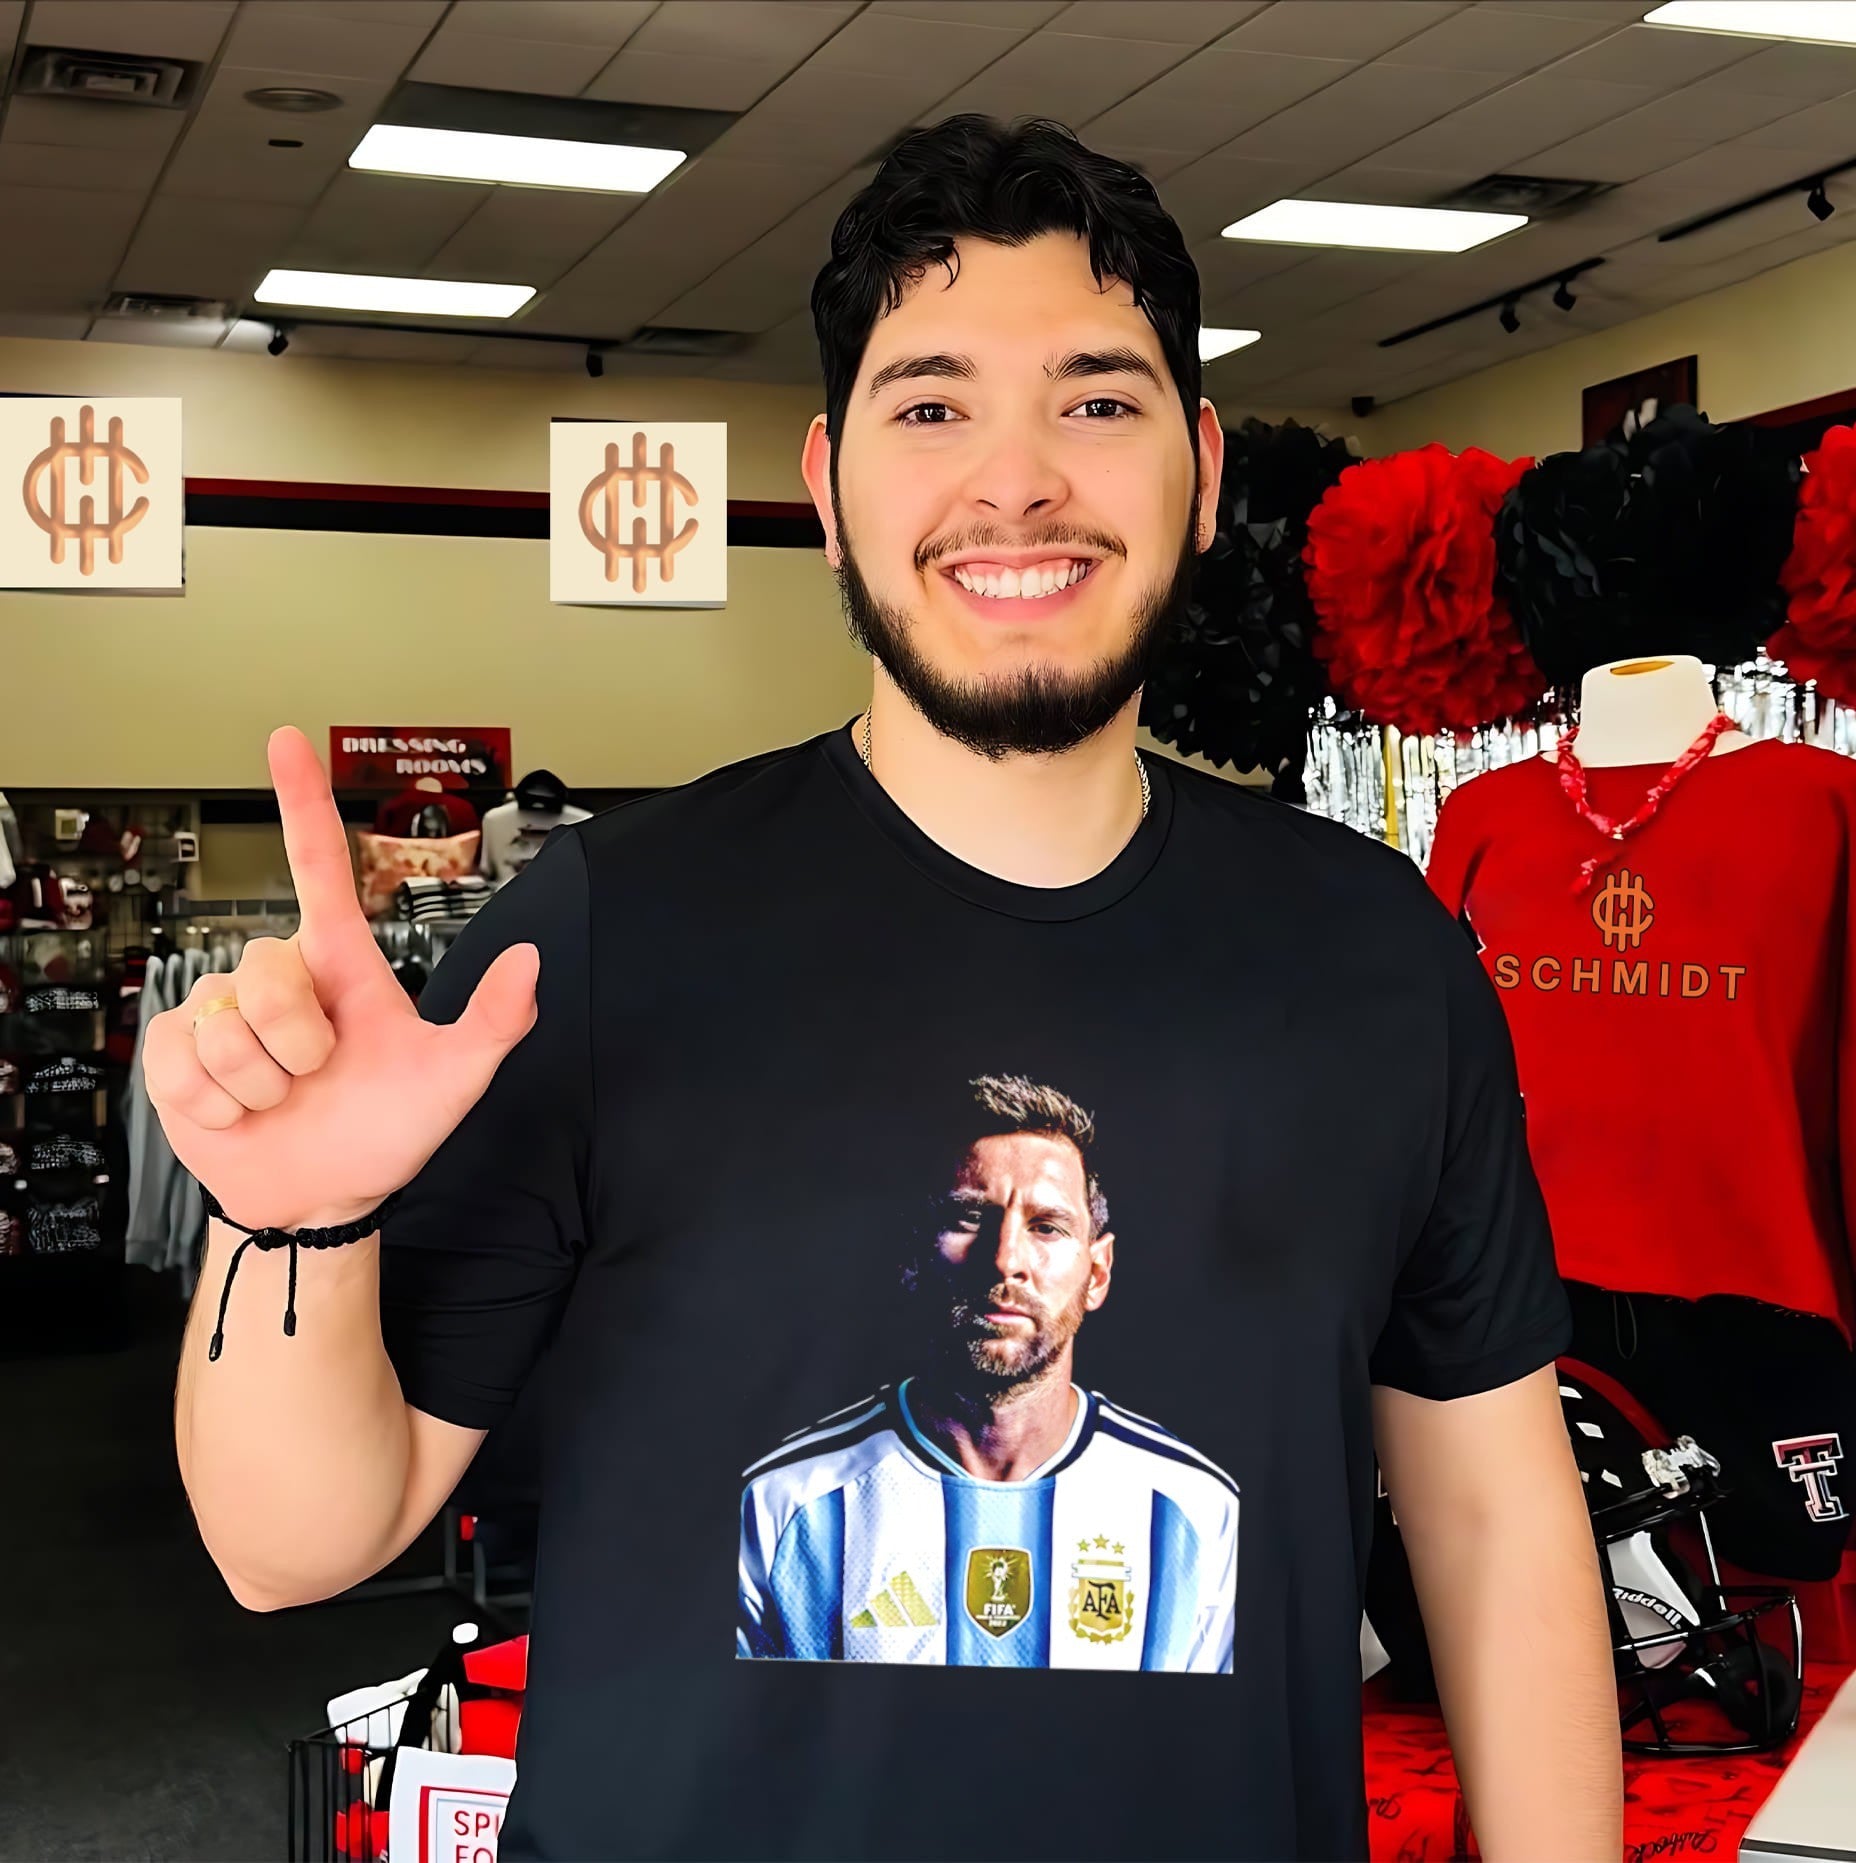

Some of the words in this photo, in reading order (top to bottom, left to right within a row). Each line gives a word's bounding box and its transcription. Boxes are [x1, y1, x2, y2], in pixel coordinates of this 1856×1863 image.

[396, 758, 487, 775] ROOMS
[1494, 954, 1747, 1000] SCHMIDT
[983, 1603, 1015, 1616] FIFA
[1082, 1580, 1121, 1621] AFA
